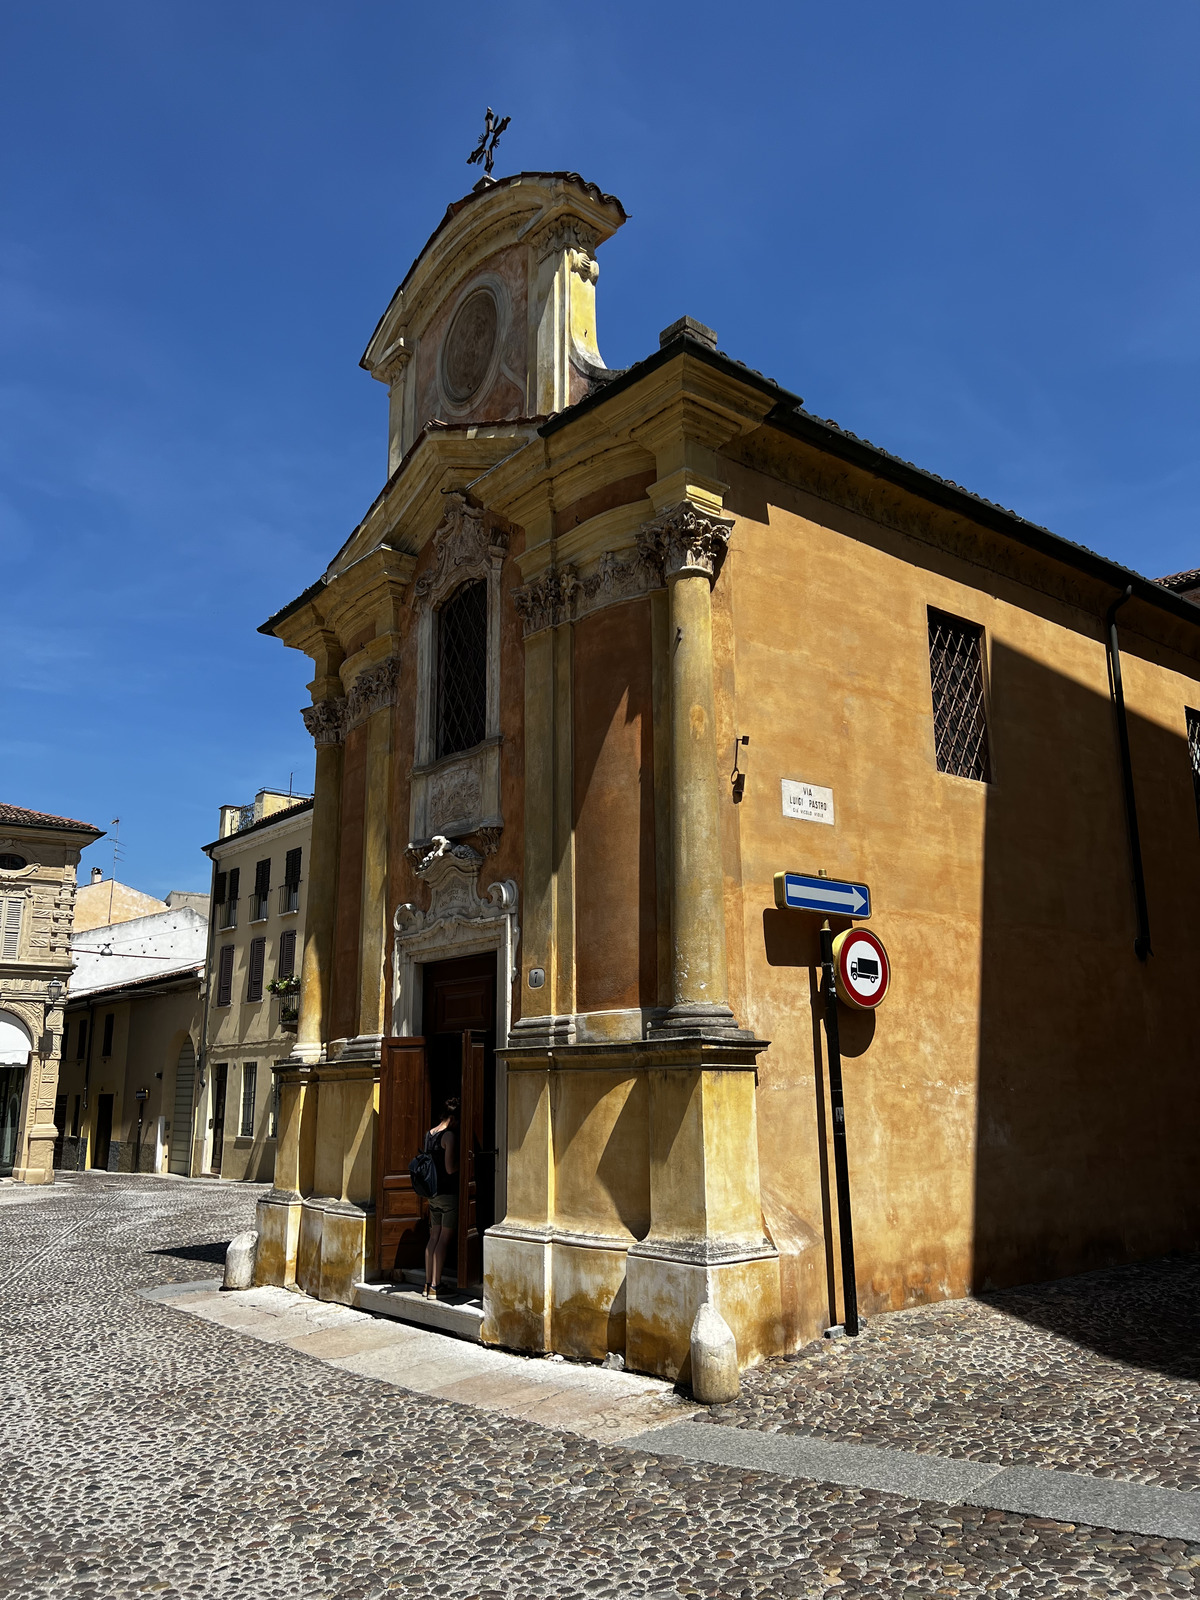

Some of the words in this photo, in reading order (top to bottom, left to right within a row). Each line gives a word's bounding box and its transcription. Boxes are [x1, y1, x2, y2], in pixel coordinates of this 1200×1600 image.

[802, 787, 813, 796] VIA
[789, 795, 804, 806] LUIGI
[808, 799, 827, 811] PASTRO
